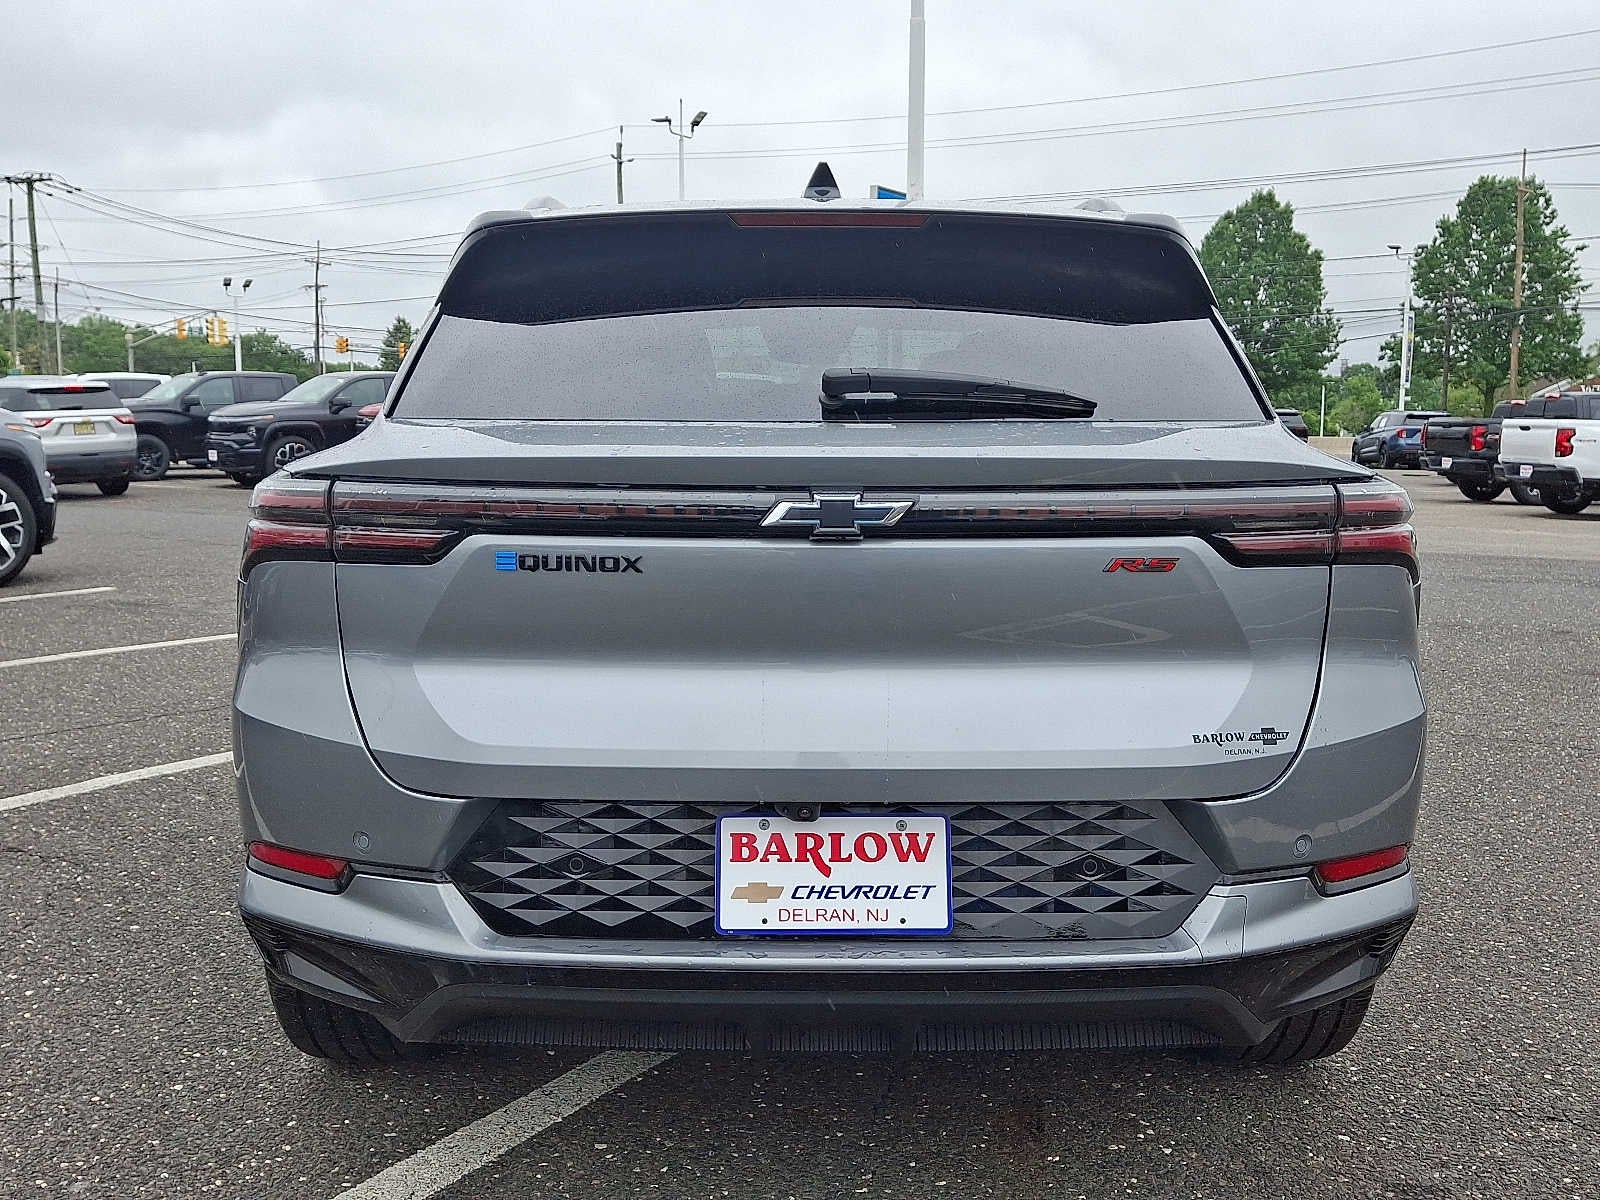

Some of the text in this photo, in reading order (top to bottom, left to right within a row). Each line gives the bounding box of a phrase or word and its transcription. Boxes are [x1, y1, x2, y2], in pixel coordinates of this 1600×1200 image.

[495, 551, 643, 574] EQUINOX
[1102, 557, 1180, 573] RS
[1192, 732, 1287, 747] BARLOW CHEVROLET
[729, 832, 936, 878] BARLOW
[790, 885, 937, 900] CHEVROLET
[778, 908, 889, 923] DELRAN, NJ
